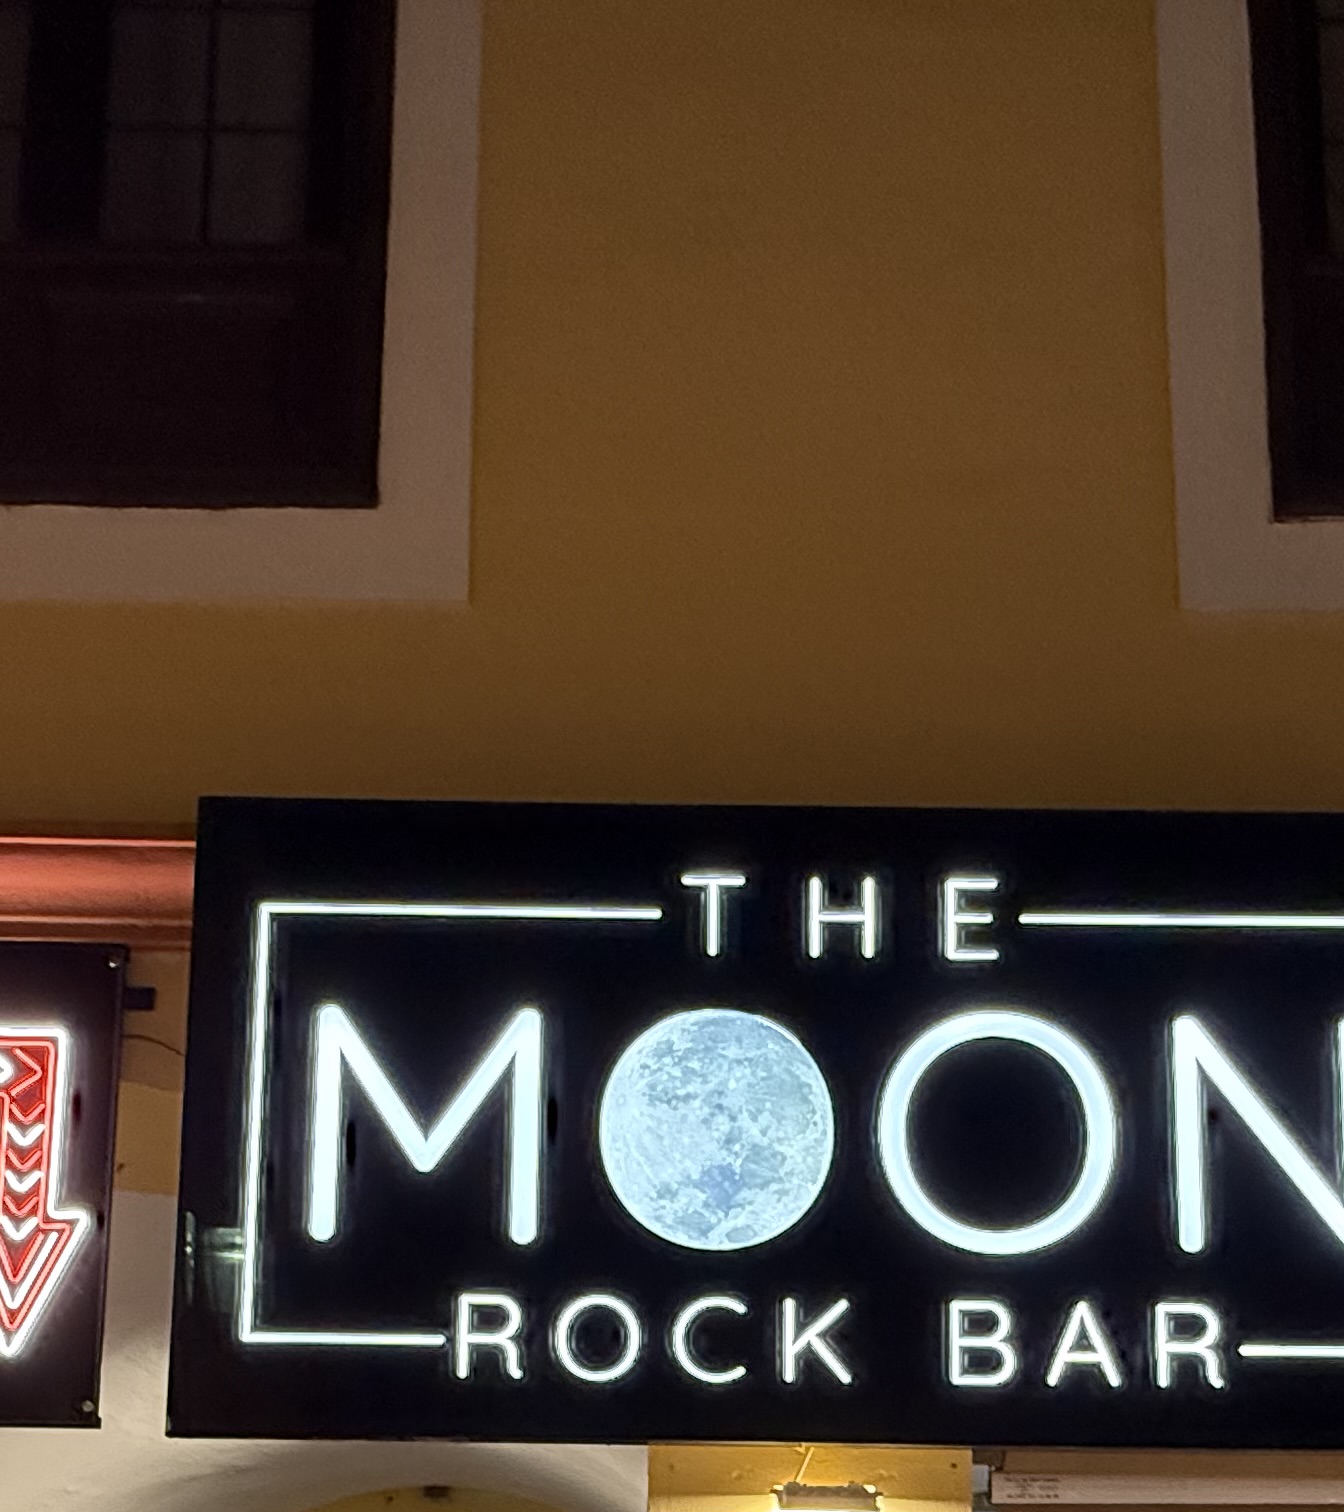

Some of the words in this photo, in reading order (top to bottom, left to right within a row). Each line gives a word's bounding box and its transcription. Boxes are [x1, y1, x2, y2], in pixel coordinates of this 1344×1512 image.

[681, 873, 999, 961] THE
[456, 1293, 852, 1384] ROCK
[948, 1300, 1225, 1389] BAR
